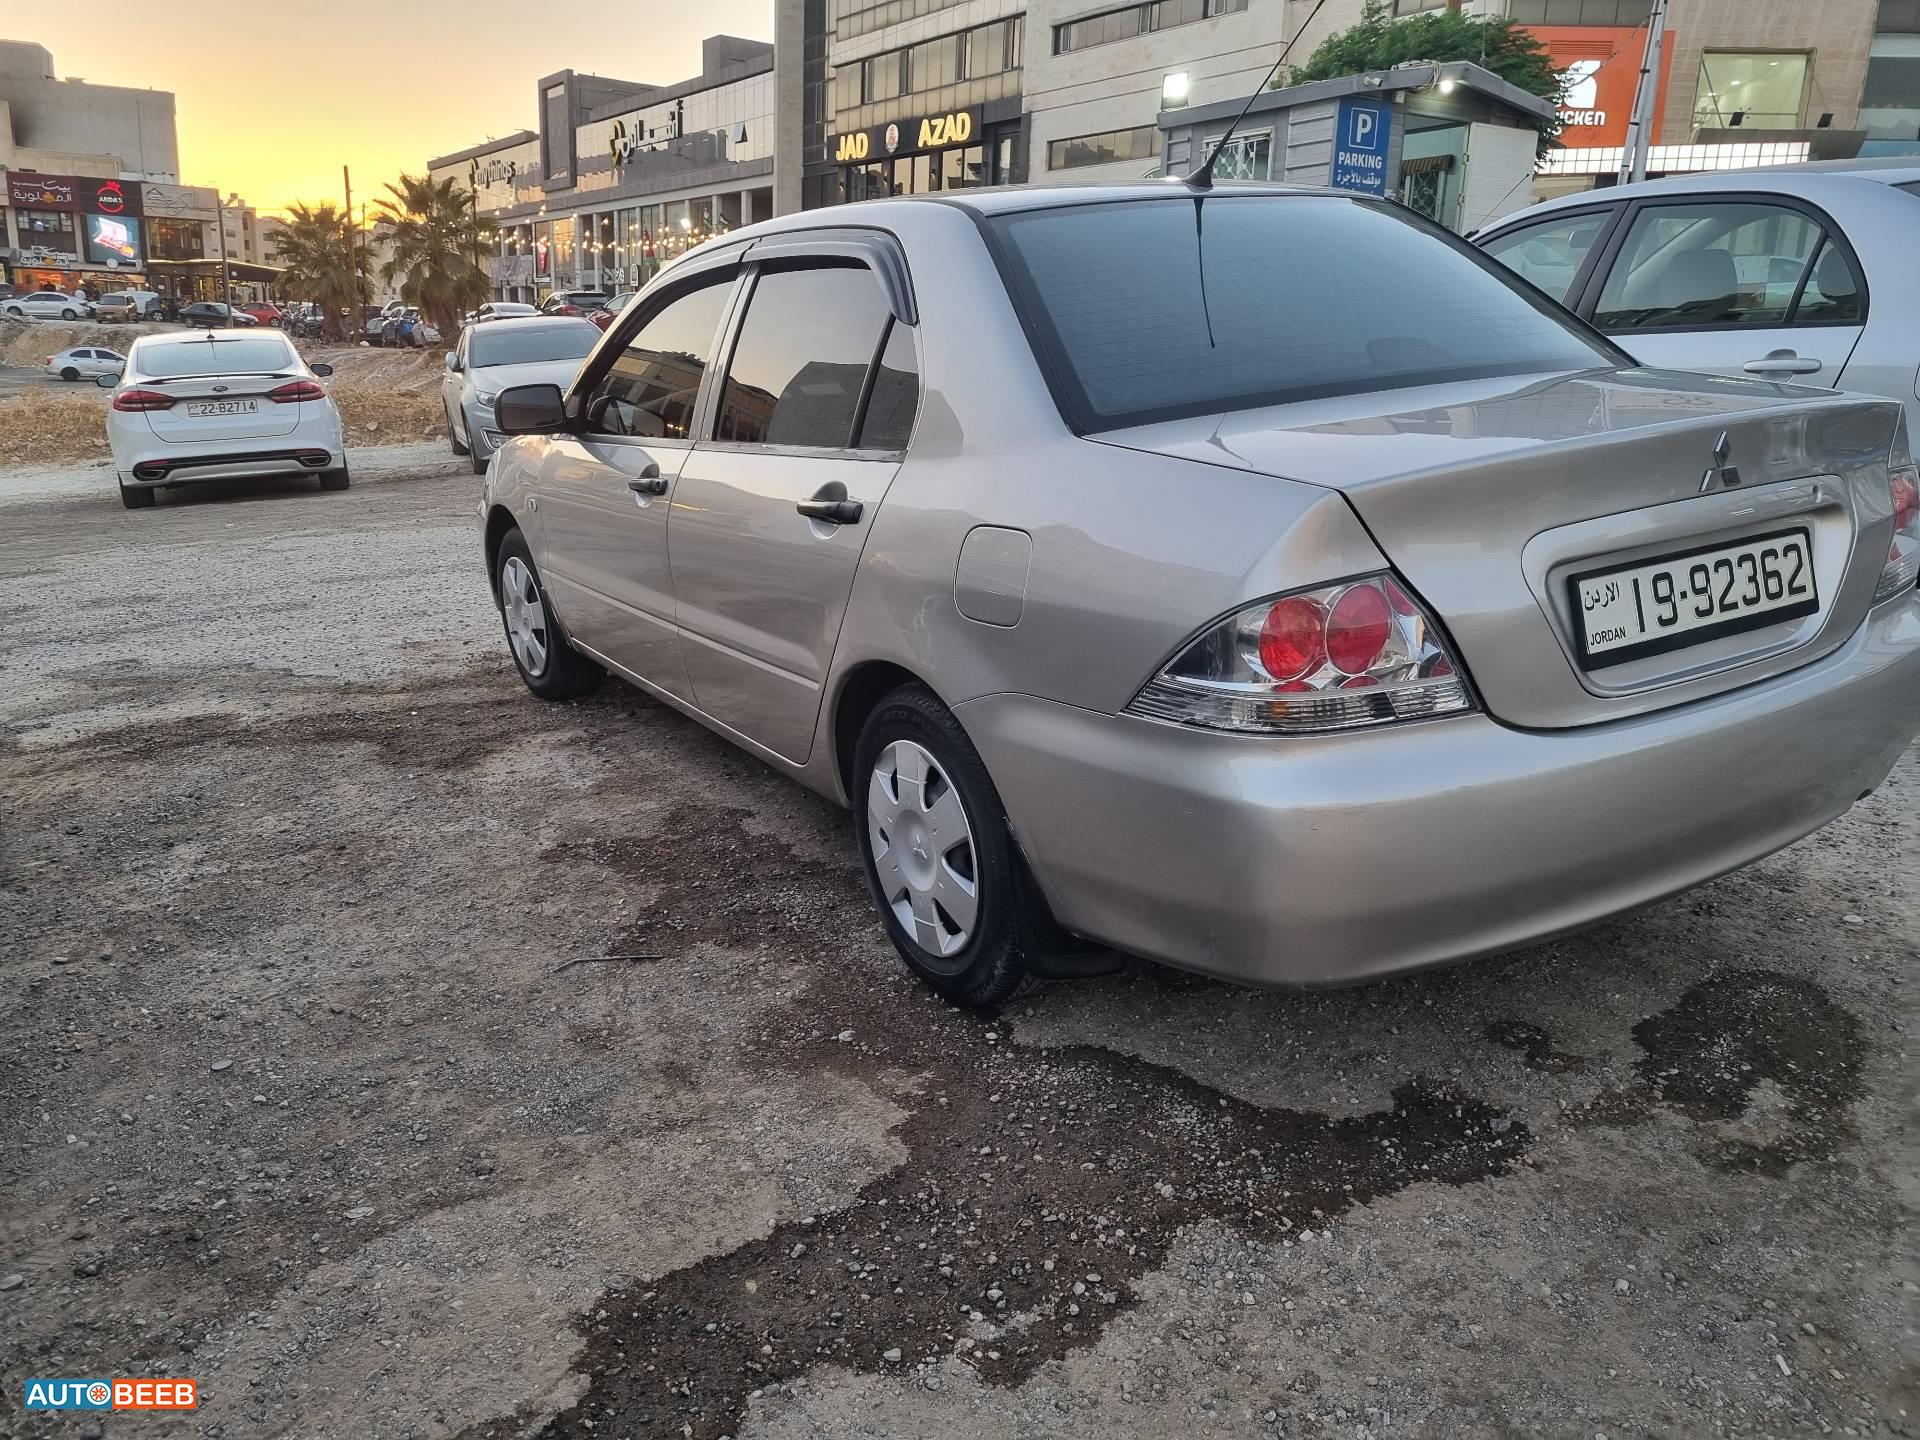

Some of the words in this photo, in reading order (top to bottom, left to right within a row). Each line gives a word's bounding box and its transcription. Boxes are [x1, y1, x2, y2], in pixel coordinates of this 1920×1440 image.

[835, 132, 869, 161] JAD
[917, 112, 971, 148] AZAD
[1356, 113, 1372, 143] P
[1338, 151, 1383, 169] PARKING
[1361, 172, 1381, 188] موقف
[1584, 582, 1620, 611] الاردن
[1632, 543, 1807, 633] 19-92362
[1590, 626, 1627, 646] JORDAN
